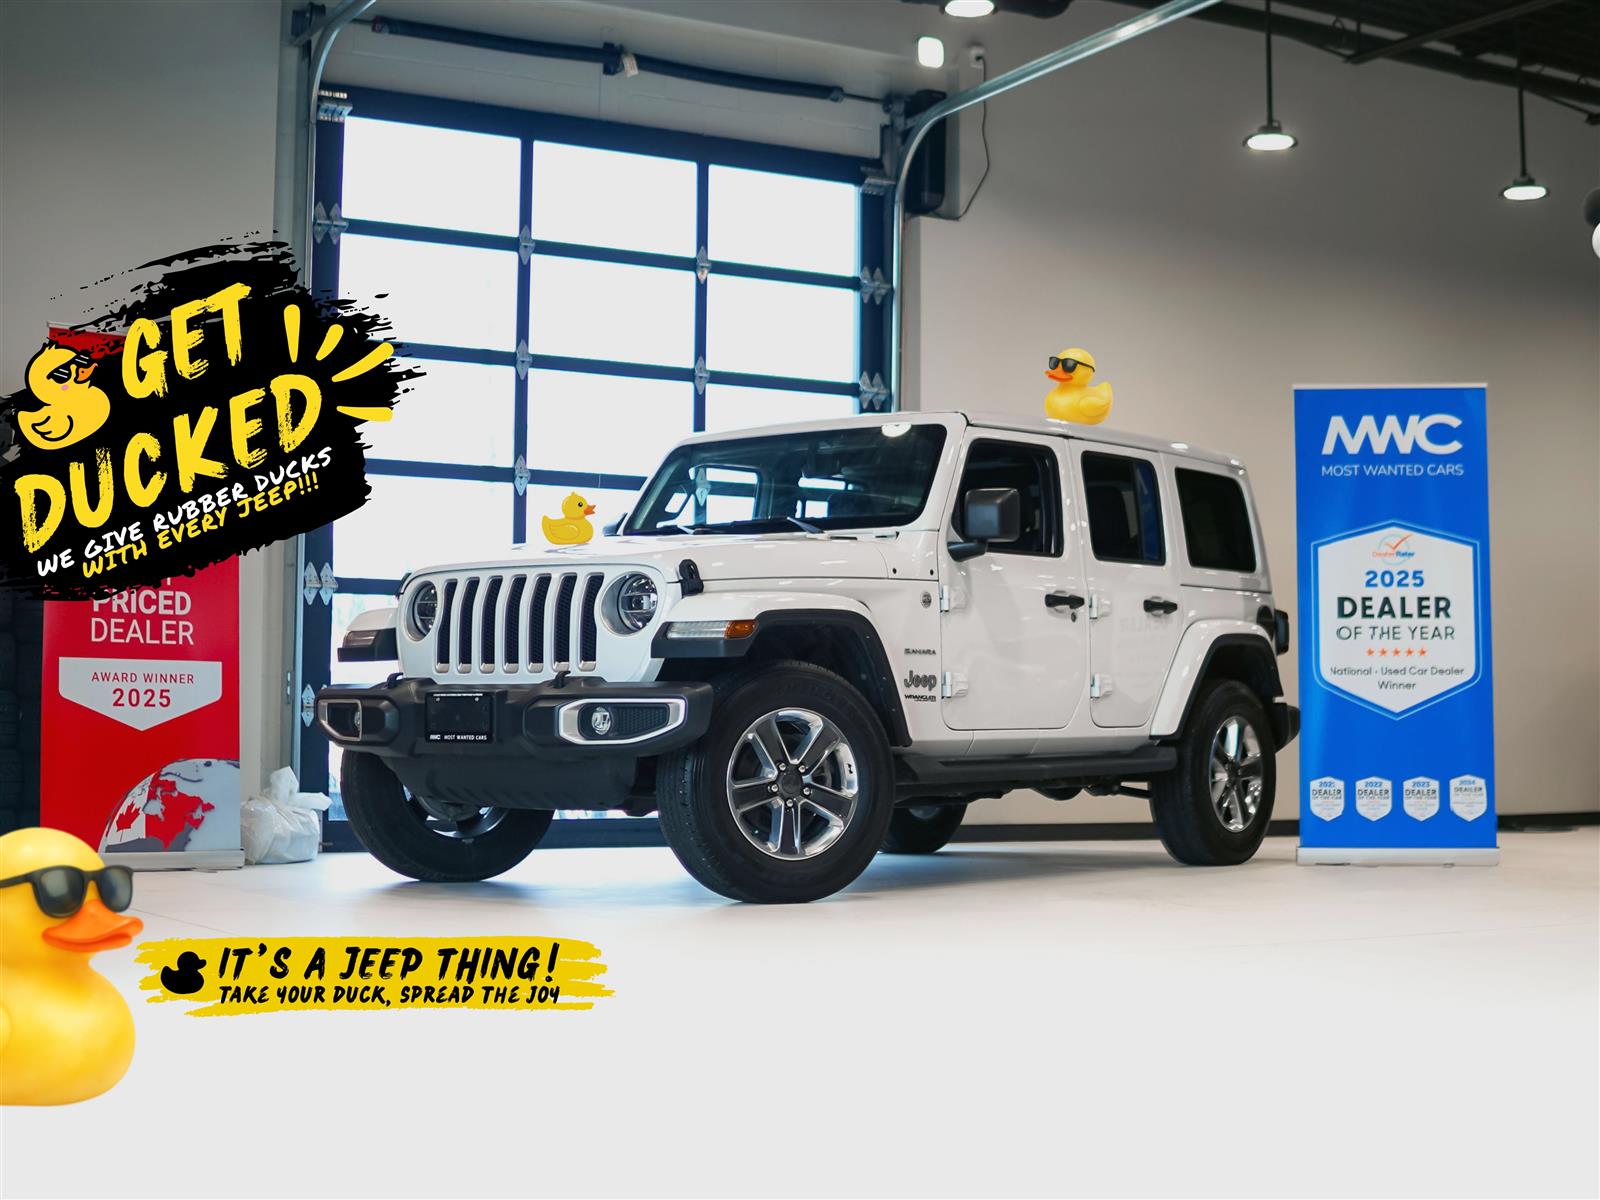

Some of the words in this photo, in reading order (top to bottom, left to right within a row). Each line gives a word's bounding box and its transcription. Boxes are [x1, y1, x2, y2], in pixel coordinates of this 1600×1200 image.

[1321, 413, 1464, 455] MWC
[1321, 465, 1360, 477] MOST
[1363, 464, 1424, 476] WANTED
[1427, 464, 1464, 476] CARS
[1365, 570, 1425, 588] 2025
[1337, 596, 1452, 619] DEALER
[90, 617, 195, 645] DEALER
[1336, 626, 1362, 640] OF
[1369, 626, 1401, 640] THE
[1408, 626, 1455, 640] YEAR
[91, 671, 138, 683] AWARD
[143, 672, 195, 684] WINNER
[1381, 666, 1406, 676] Used
[1408, 666, 1429, 676] Car
[1430, 666, 1465, 676] Dealer
[904, 670, 937, 691] Jeep
[1377, 680, 1416, 690] Winner
[112, 688, 171, 708] 2025
